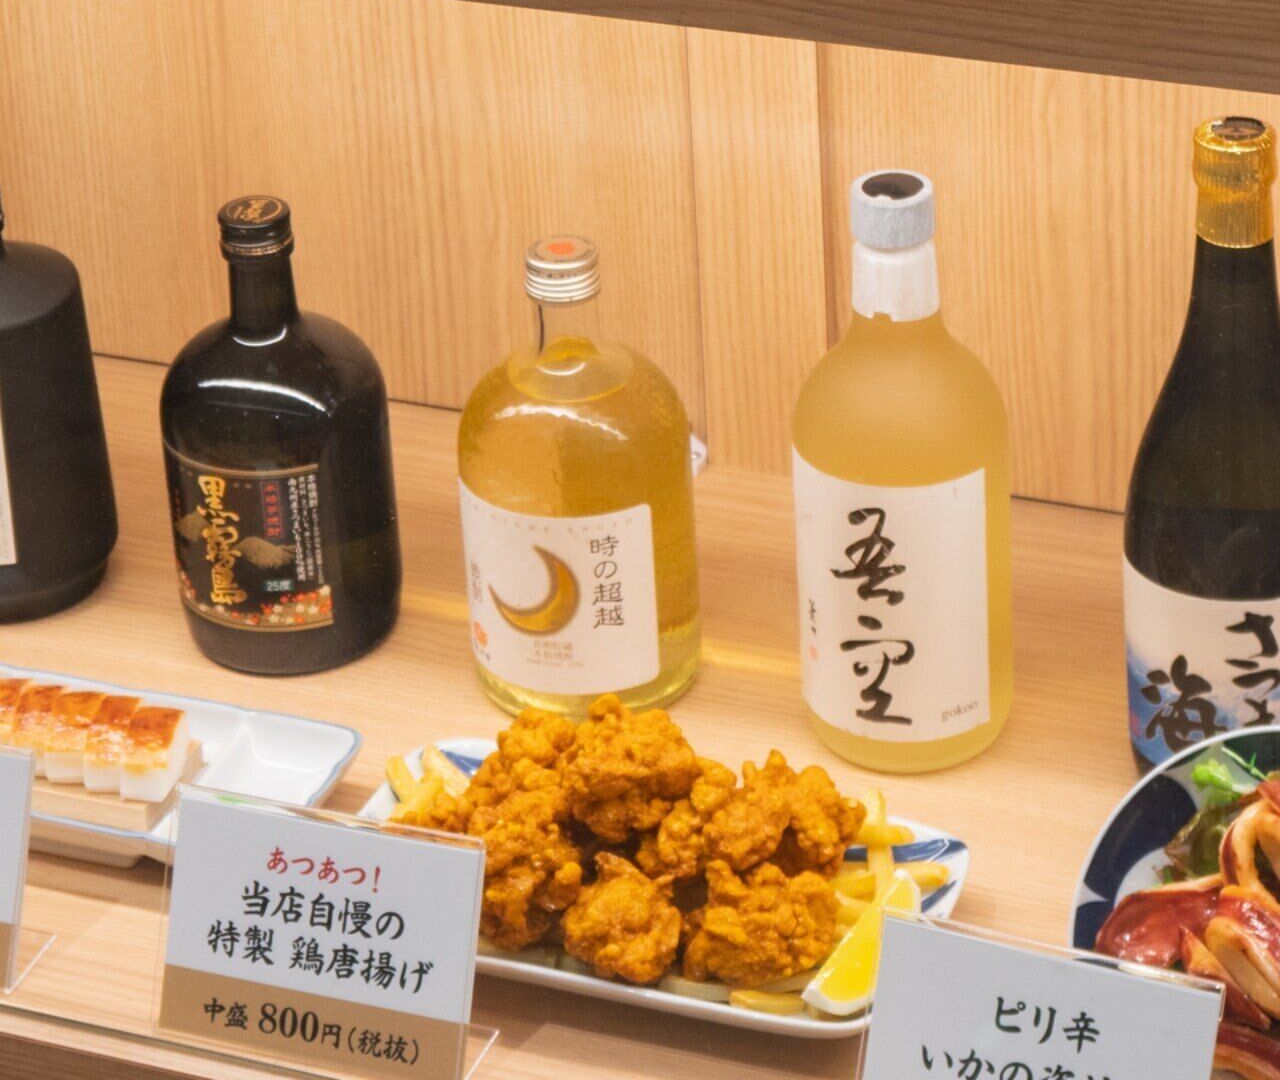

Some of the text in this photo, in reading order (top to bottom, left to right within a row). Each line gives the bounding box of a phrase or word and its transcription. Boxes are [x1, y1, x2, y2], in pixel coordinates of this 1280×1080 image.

[589, 535, 625, 630] 時の超越
[267, 846, 381, 894] あつあつ！
[241, 880, 405, 941] 当店自慢の
[993, 996, 1101, 1054] ピリ辛
[921, 1044, 1111, 1080] いかの
